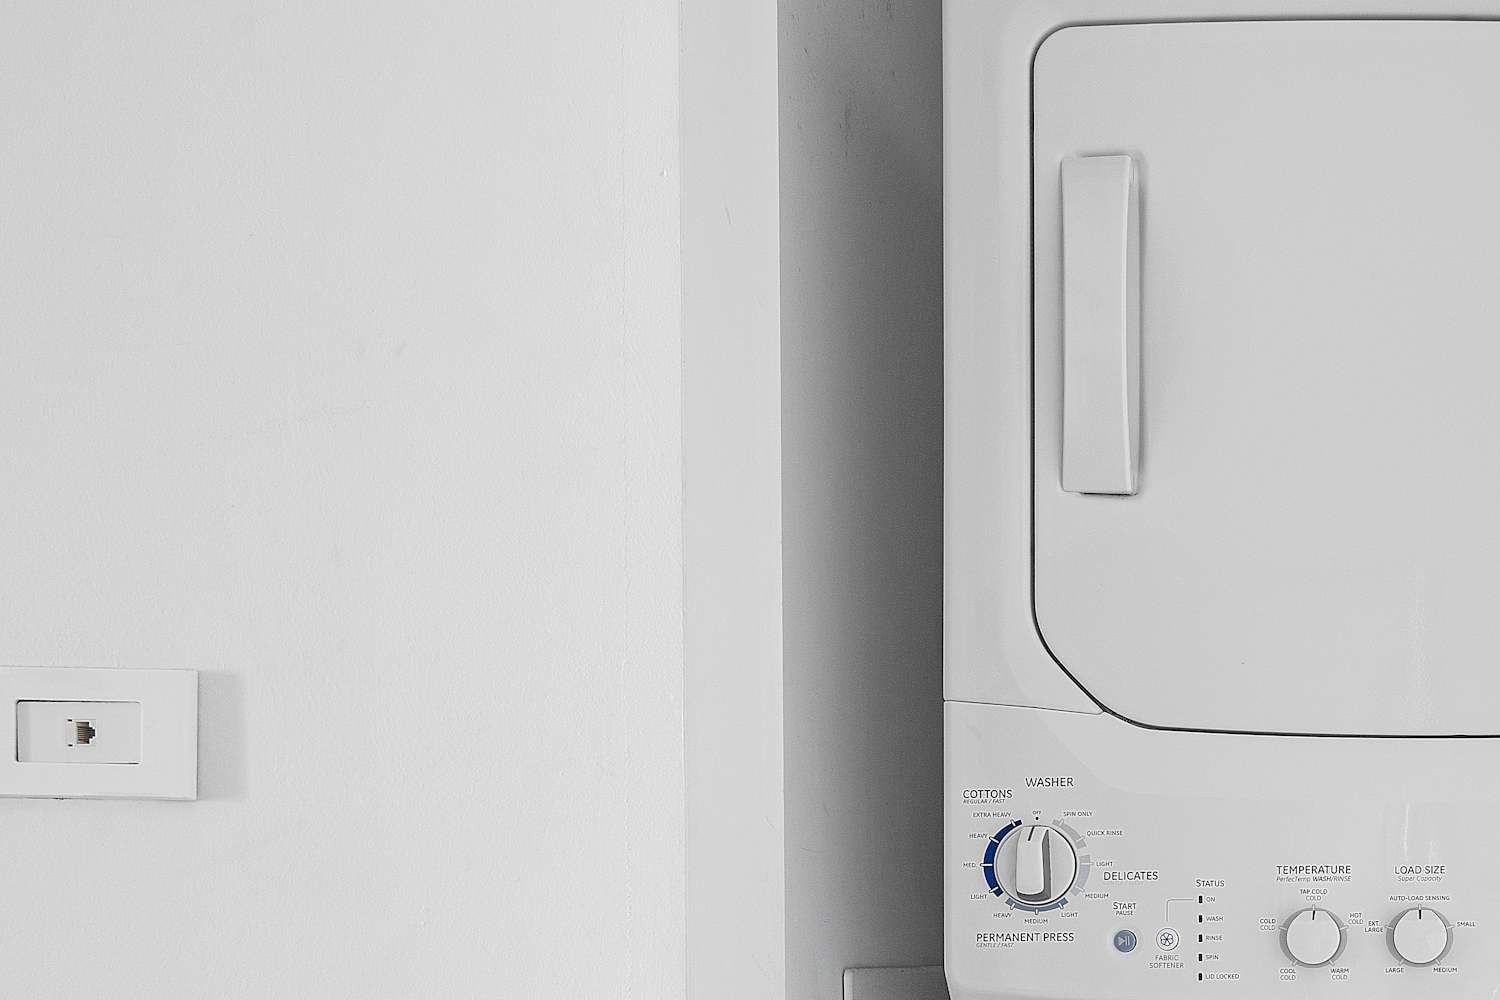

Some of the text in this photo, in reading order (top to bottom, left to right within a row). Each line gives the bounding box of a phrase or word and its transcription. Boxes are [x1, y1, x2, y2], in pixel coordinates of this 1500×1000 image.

[1025, 777, 1074, 788] WASHER
[962, 789, 1013, 799] COTTONS
[1276, 865, 1352, 874] TEMPERATURE
[1394, 866, 1446, 874] LOAD SIZE
[1103, 871, 1159, 880] DELICATES
[1113, 902, 1136, 910] START
[976, 932, 1074, 942] PERMANENT PRESS
